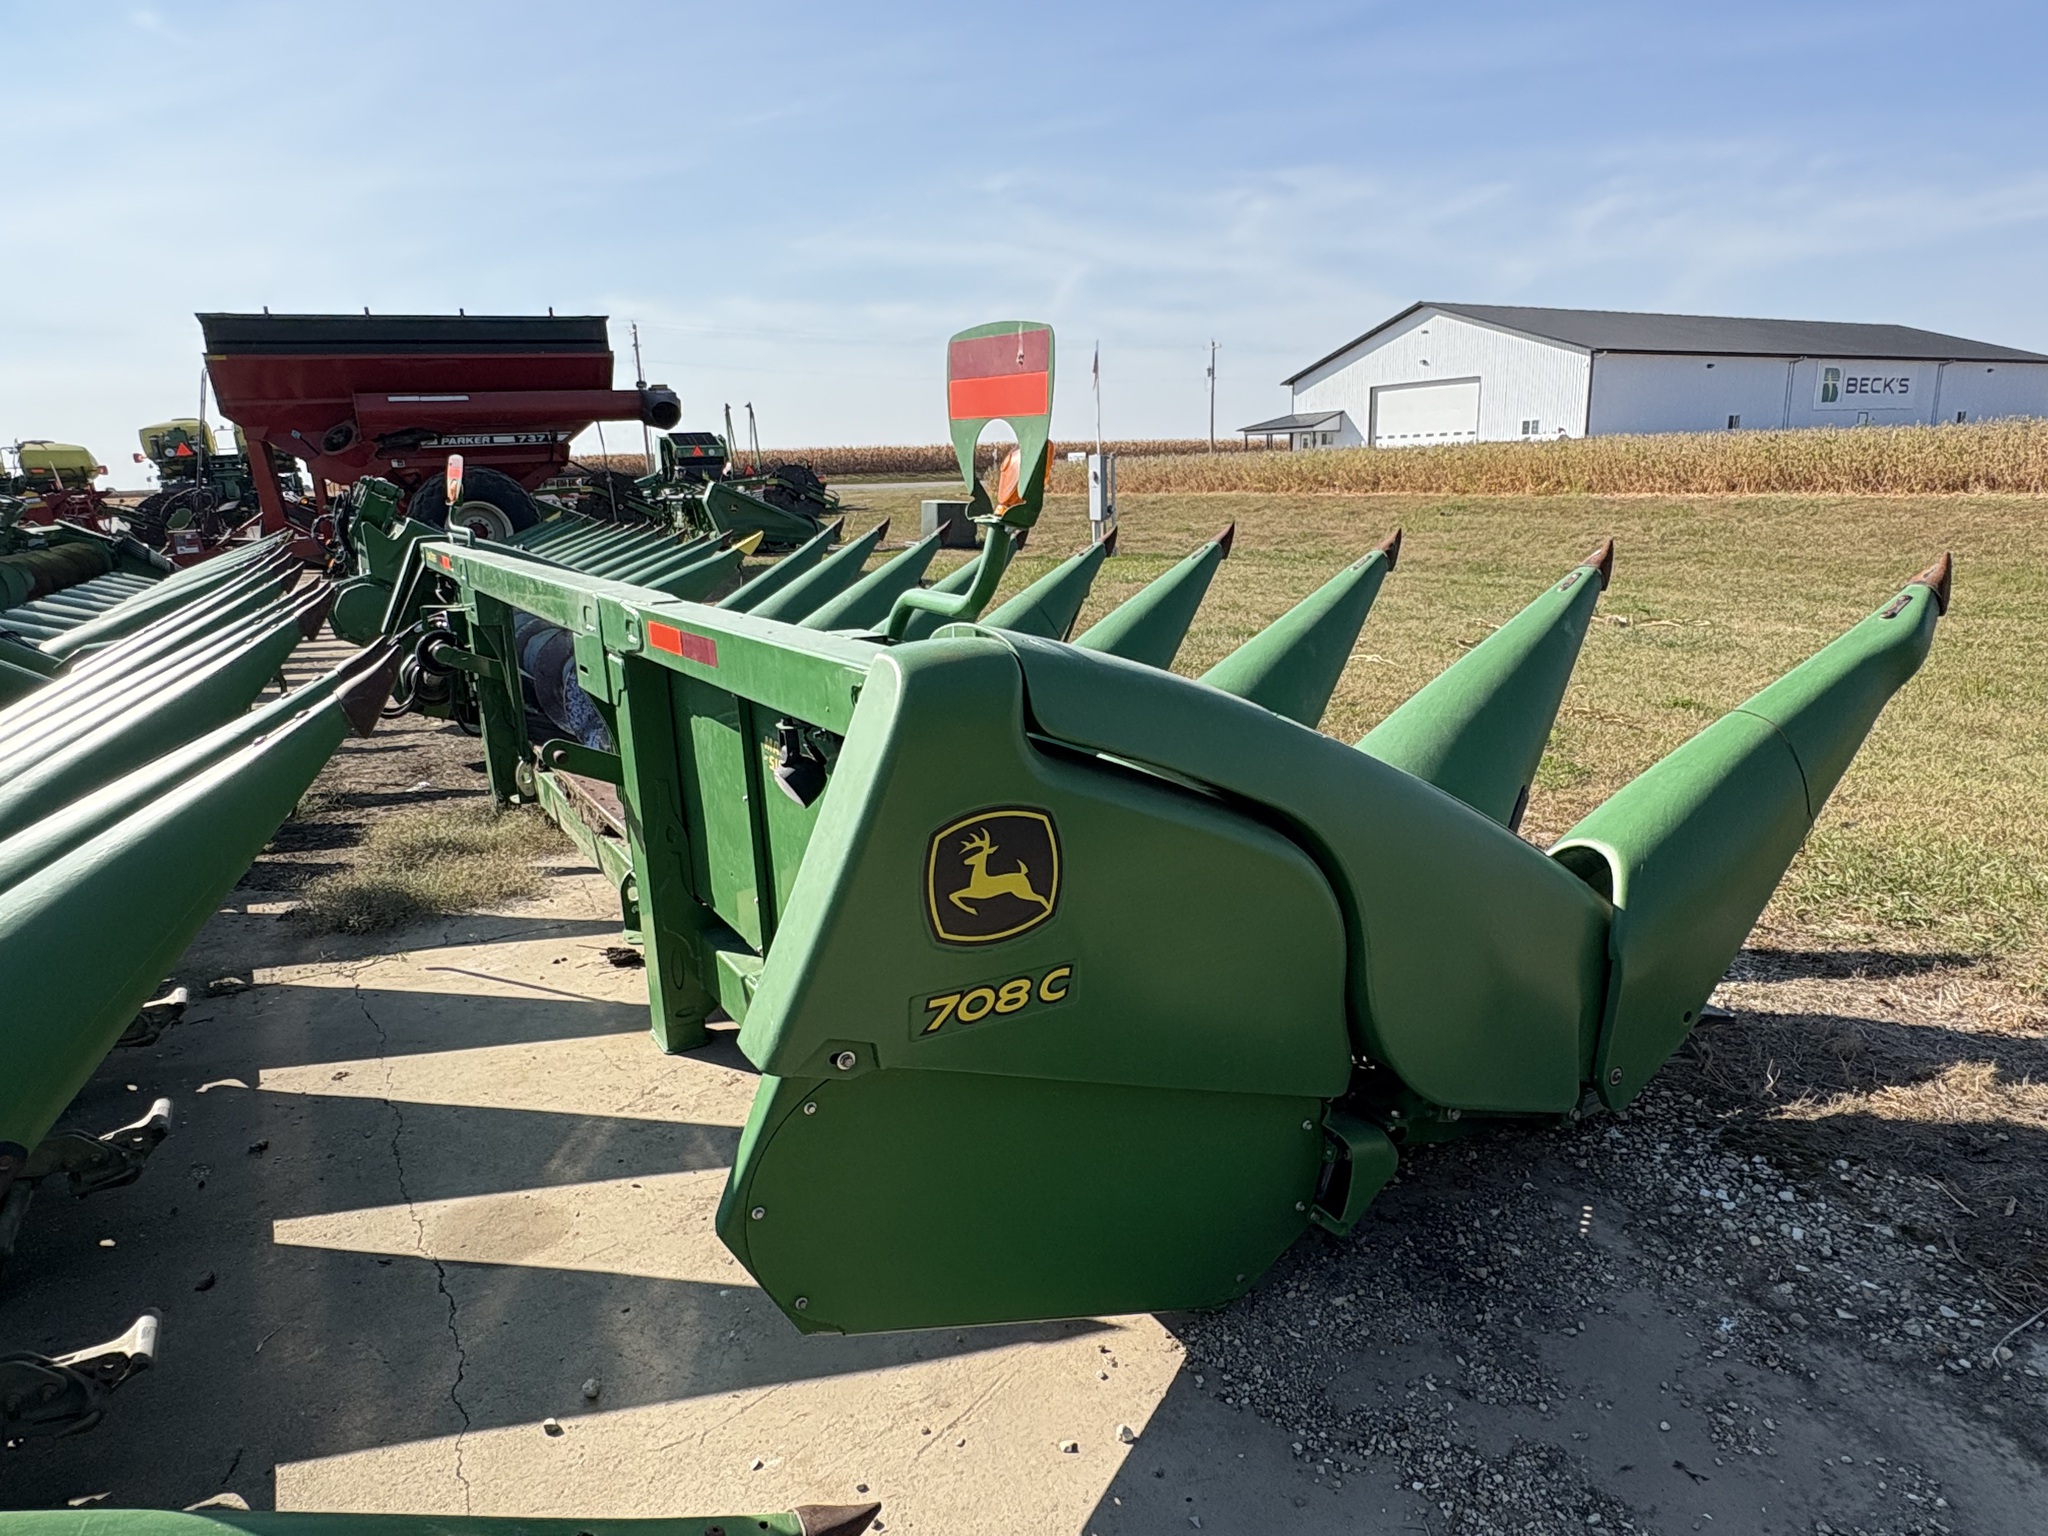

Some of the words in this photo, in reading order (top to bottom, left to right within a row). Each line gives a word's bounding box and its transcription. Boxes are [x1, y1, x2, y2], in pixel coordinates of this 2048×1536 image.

[1845, 377, 1910, 395] BECK'S
[440, 436, 491, 446] PARKER
[518, 434, 546, 444] 737
[921, 976, 1033, 1035] 708
[1037, 965, 1073, 1003] C
